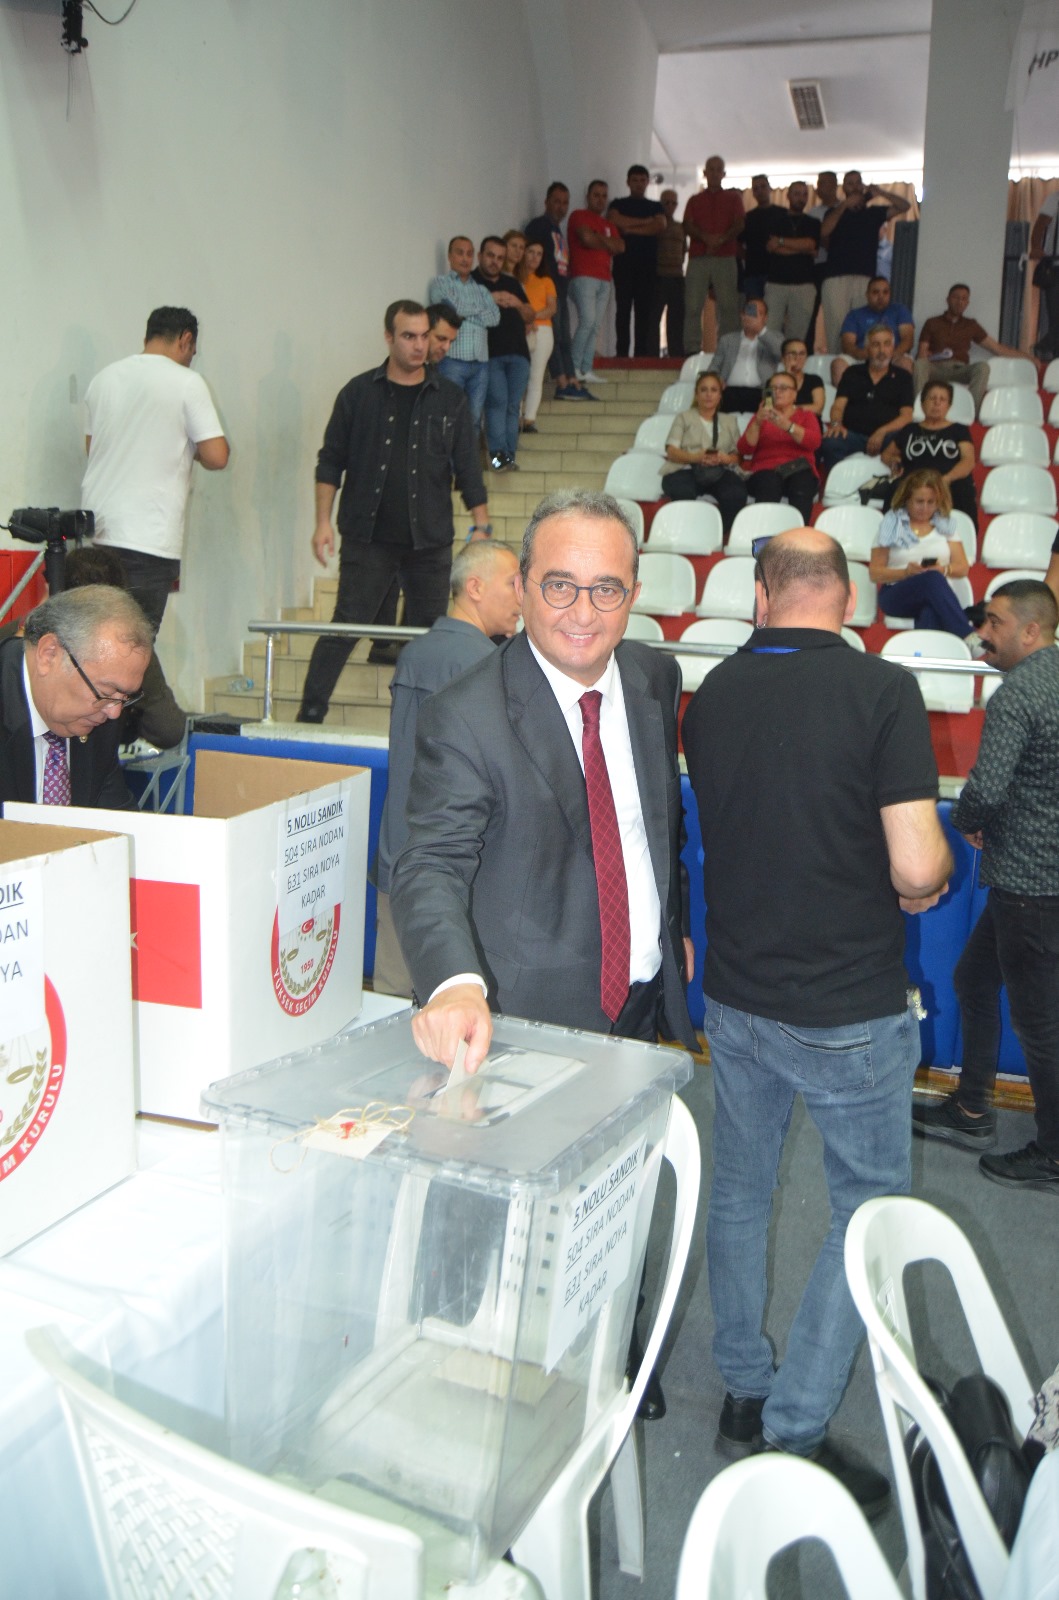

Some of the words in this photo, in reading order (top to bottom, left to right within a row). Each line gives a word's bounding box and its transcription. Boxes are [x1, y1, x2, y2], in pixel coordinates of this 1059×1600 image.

[905, 433, 959, 461] love
[287, 819, 292, 833] 5
[294, 811, 317, 830] NOLU
[317, 800, 344, 821] SANDIK
[284, 846, 299, 865] 504
[300, 837, 317, 857] SIRA
[319, 826, 344, 847] NODAN
[287, 872, 301, 890] 631
[302, 863, 319, 883] SIRA
[320, 854, 340, 873] NOYA
[301, 884, 326, 909] KADAR
[19, 1064, 63, 1154] KURULU
[573, 1207, 580, 1226] 5
[581, 1183, 607, 1214] NOLU
[608, 1147, 640, 1190] SANDIK
[566, 1236, 583, 1268] 504
[585, 1217, 604, 1249] SIRA
[605, 1182, 636, 1224] NODAN
[564, 1271, 582, 1301] 631
[583, 1249, 603, 1281] SIRA
[604, 1221, 627, 1254] NOYA
[578, 1270, 608, 1316] KADAR
